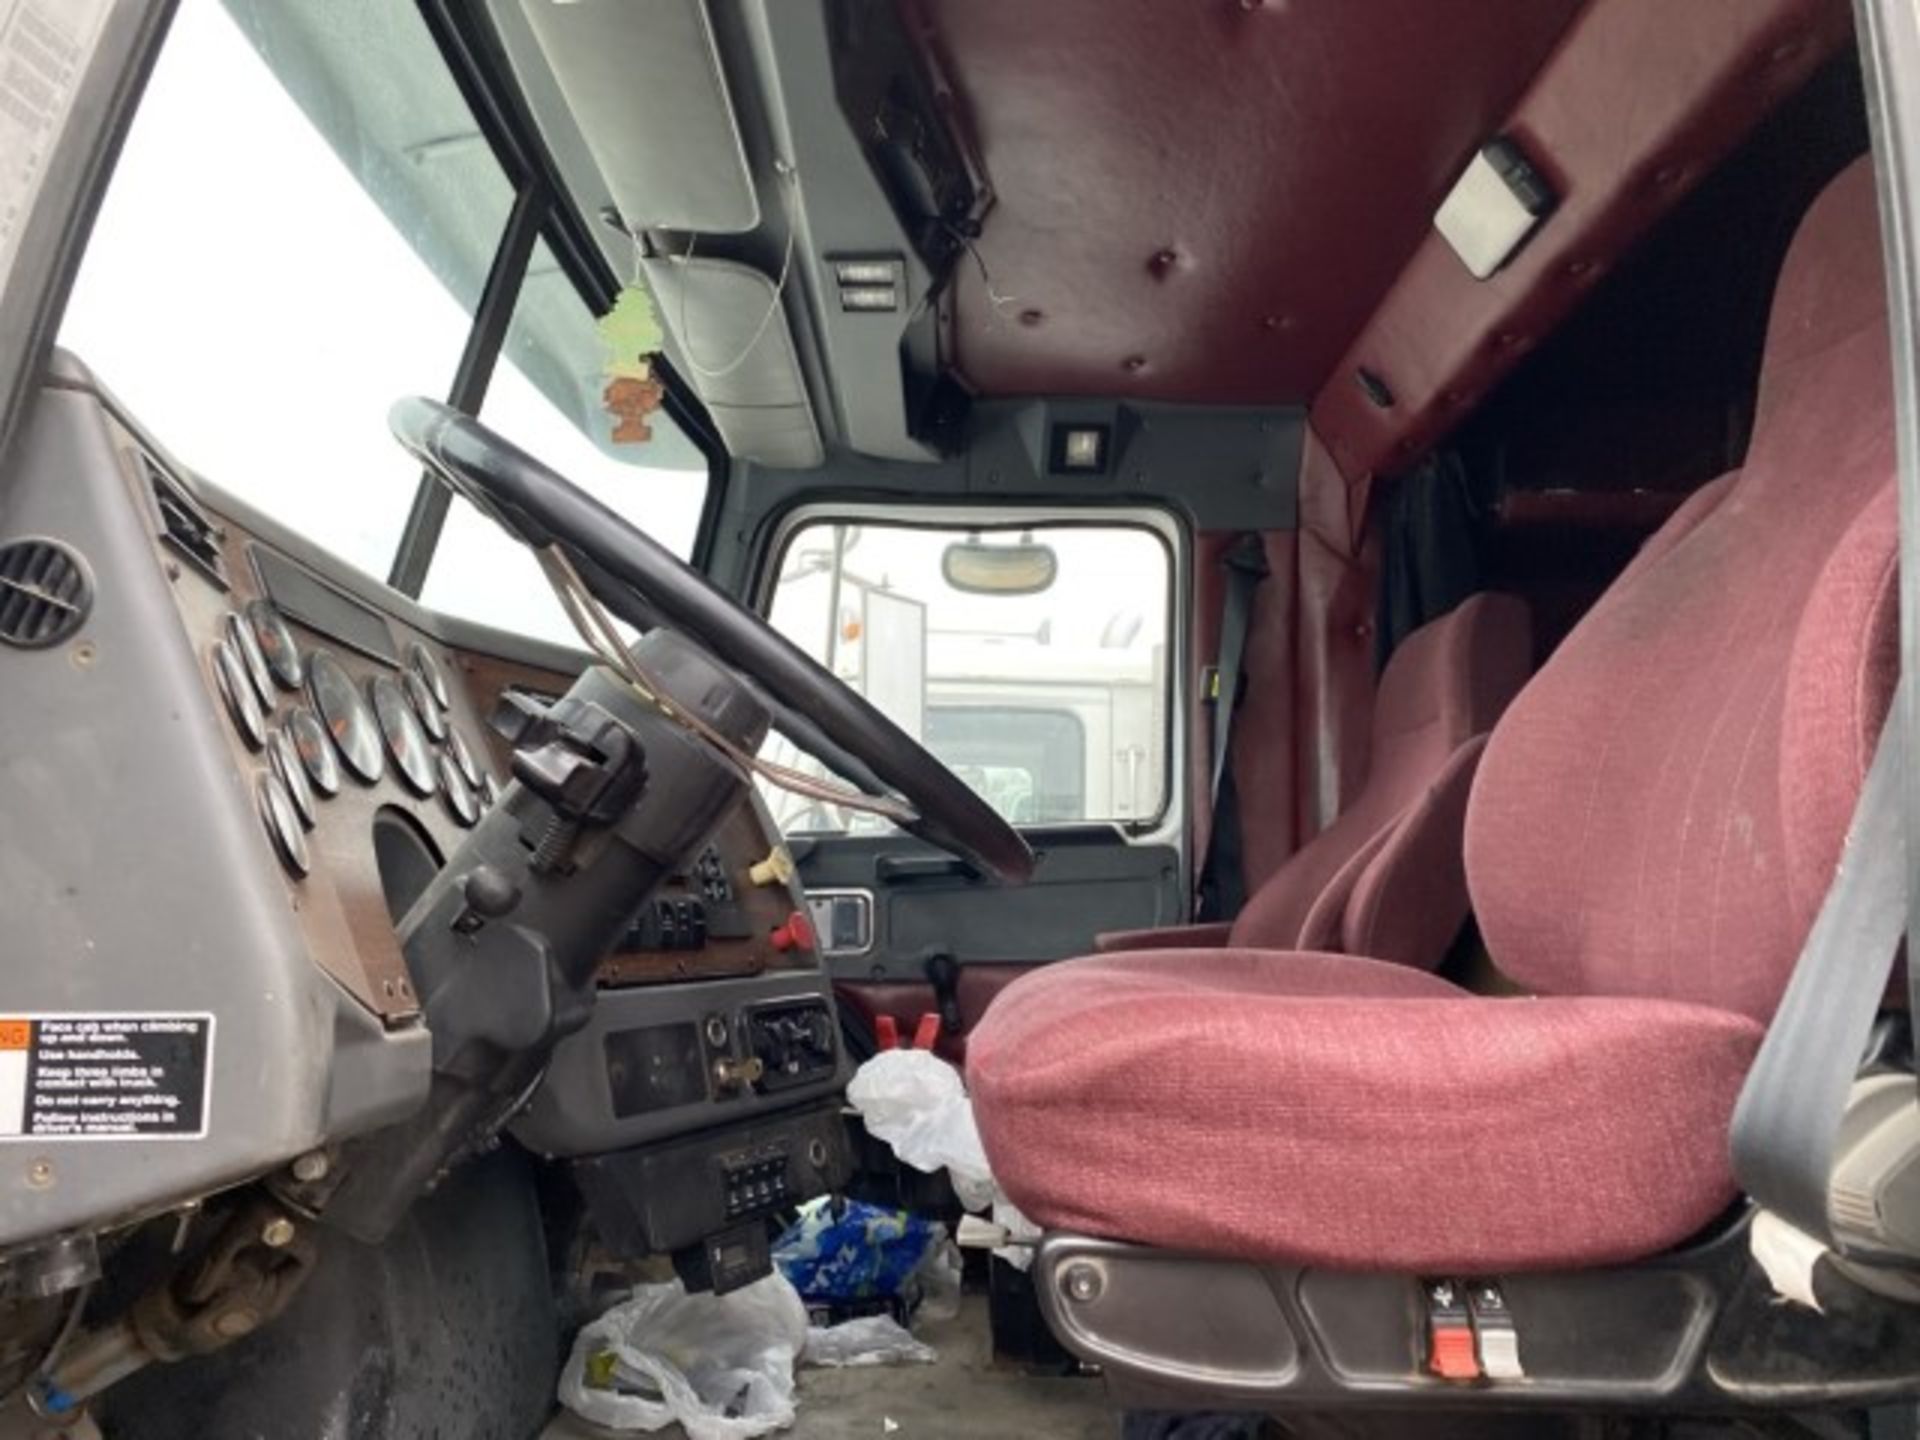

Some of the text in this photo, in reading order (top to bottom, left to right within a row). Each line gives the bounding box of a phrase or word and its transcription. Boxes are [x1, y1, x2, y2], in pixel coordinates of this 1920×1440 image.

[41, 1020, 198, 1033] Face cab when climbing
[40, 1032, 128, 1044] up and down.
[38, 1049, 141, 1060] Use handholds.
[37, 1065, 164, 1078] Keep three limbs in
[36, 1078, 157, 1088] contact with truck.
[35, 1094, 180, 1107] Do not carry anything.
[33, 1110, 175, 1123] Follow instructions in
[86, 1123, 138, 1132] manual.
